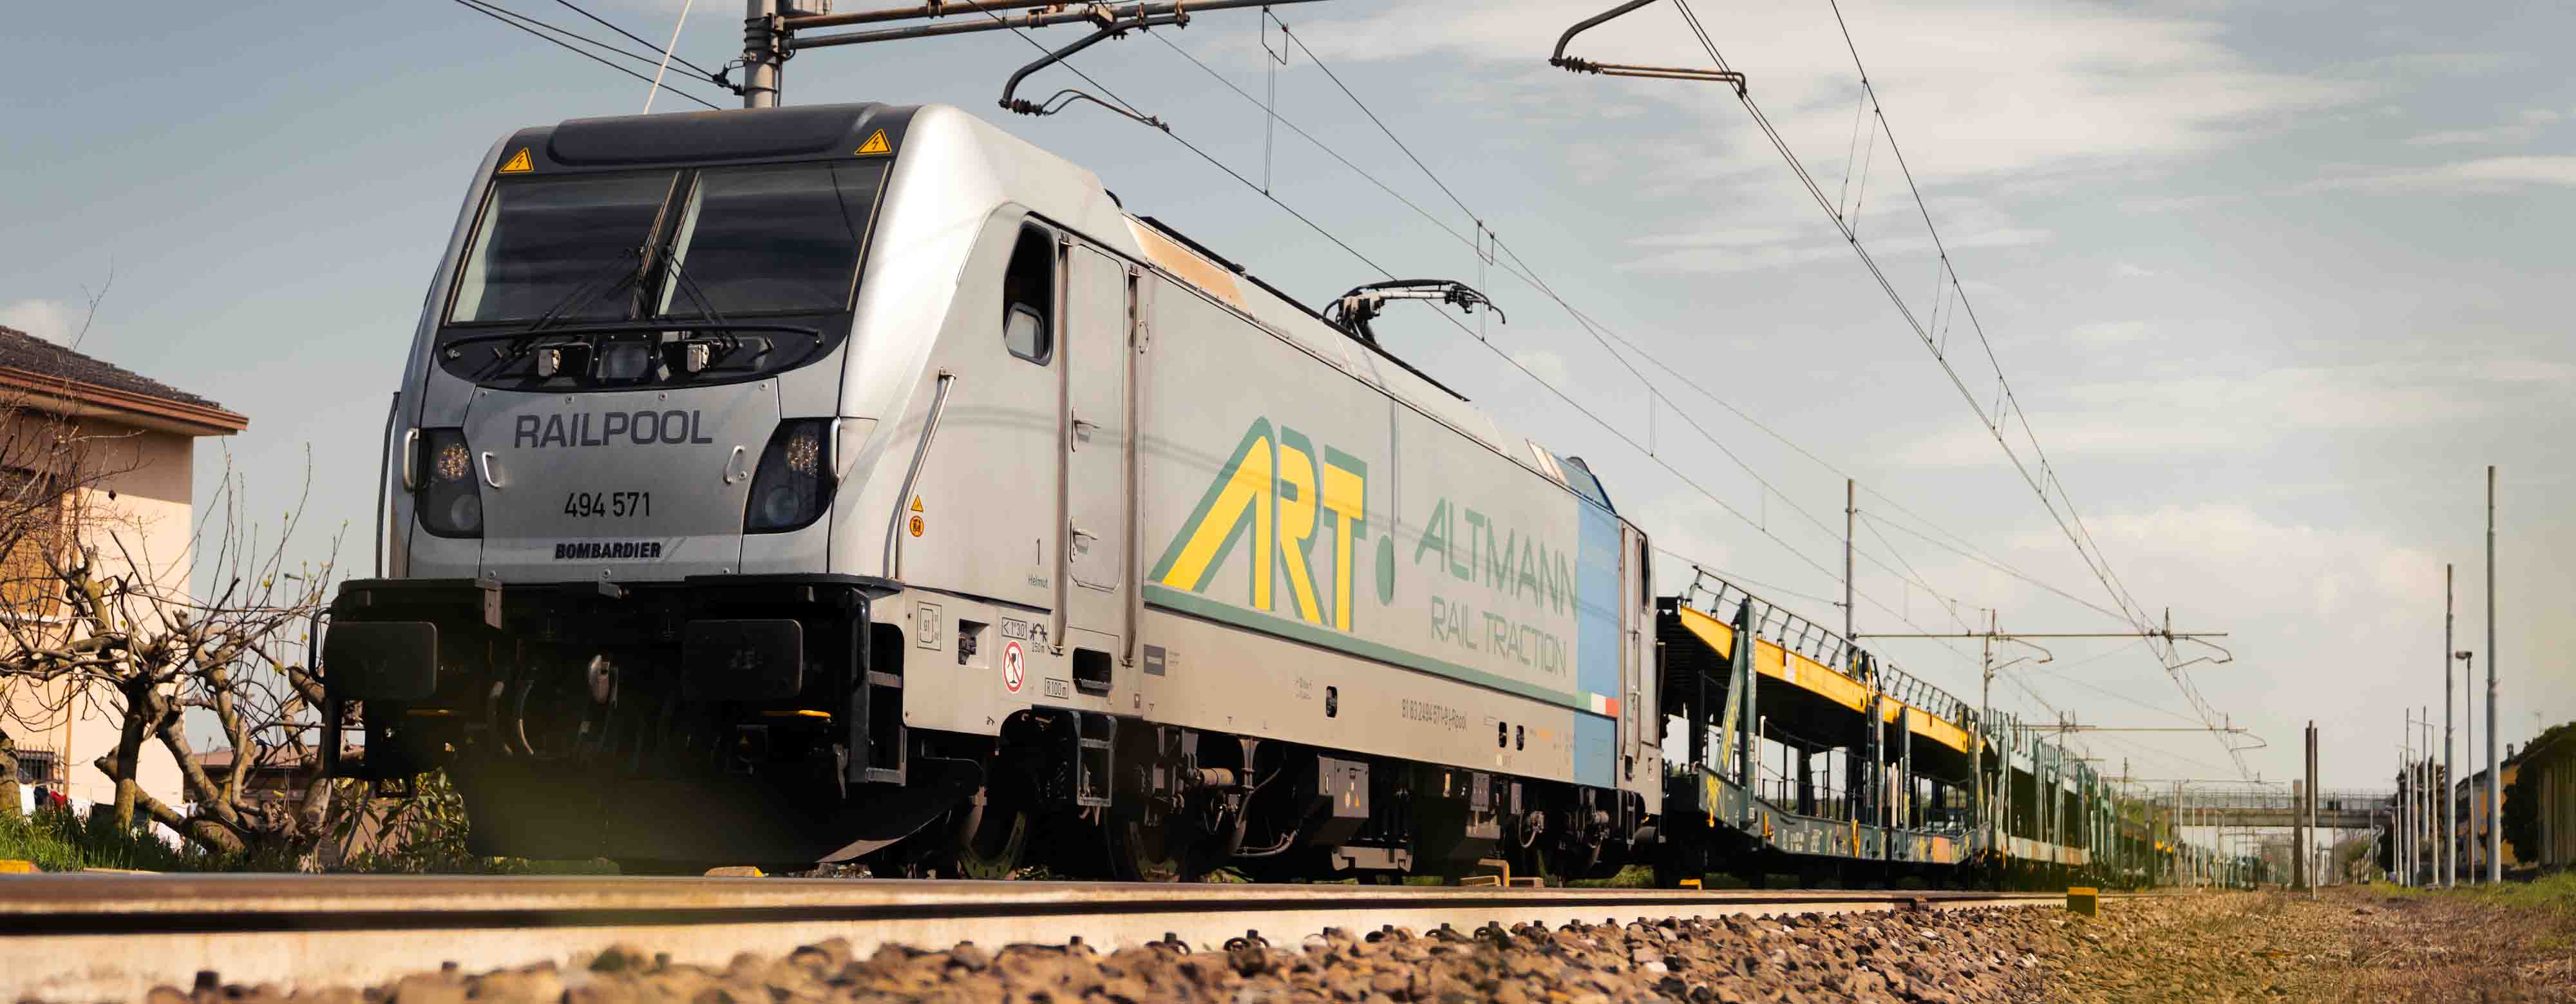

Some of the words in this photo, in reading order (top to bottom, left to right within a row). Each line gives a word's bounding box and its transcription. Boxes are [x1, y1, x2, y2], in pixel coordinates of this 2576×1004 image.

[515, 410, 712, 448] RAILPOOL
[564, 492, 605, 517] 494
[612, 491, 650, 517] 571
[554, 542, 662, 560] BOMBARDIER
[1036, 538, 1041, 566] 1
[1414, 496, 1578, 623] ALTMANN
[1027, 572, 1050, 589] Helmut
[1431, 595, 1477, 650] RAIL
[1482, 611, 1567, 678] TRACTION
